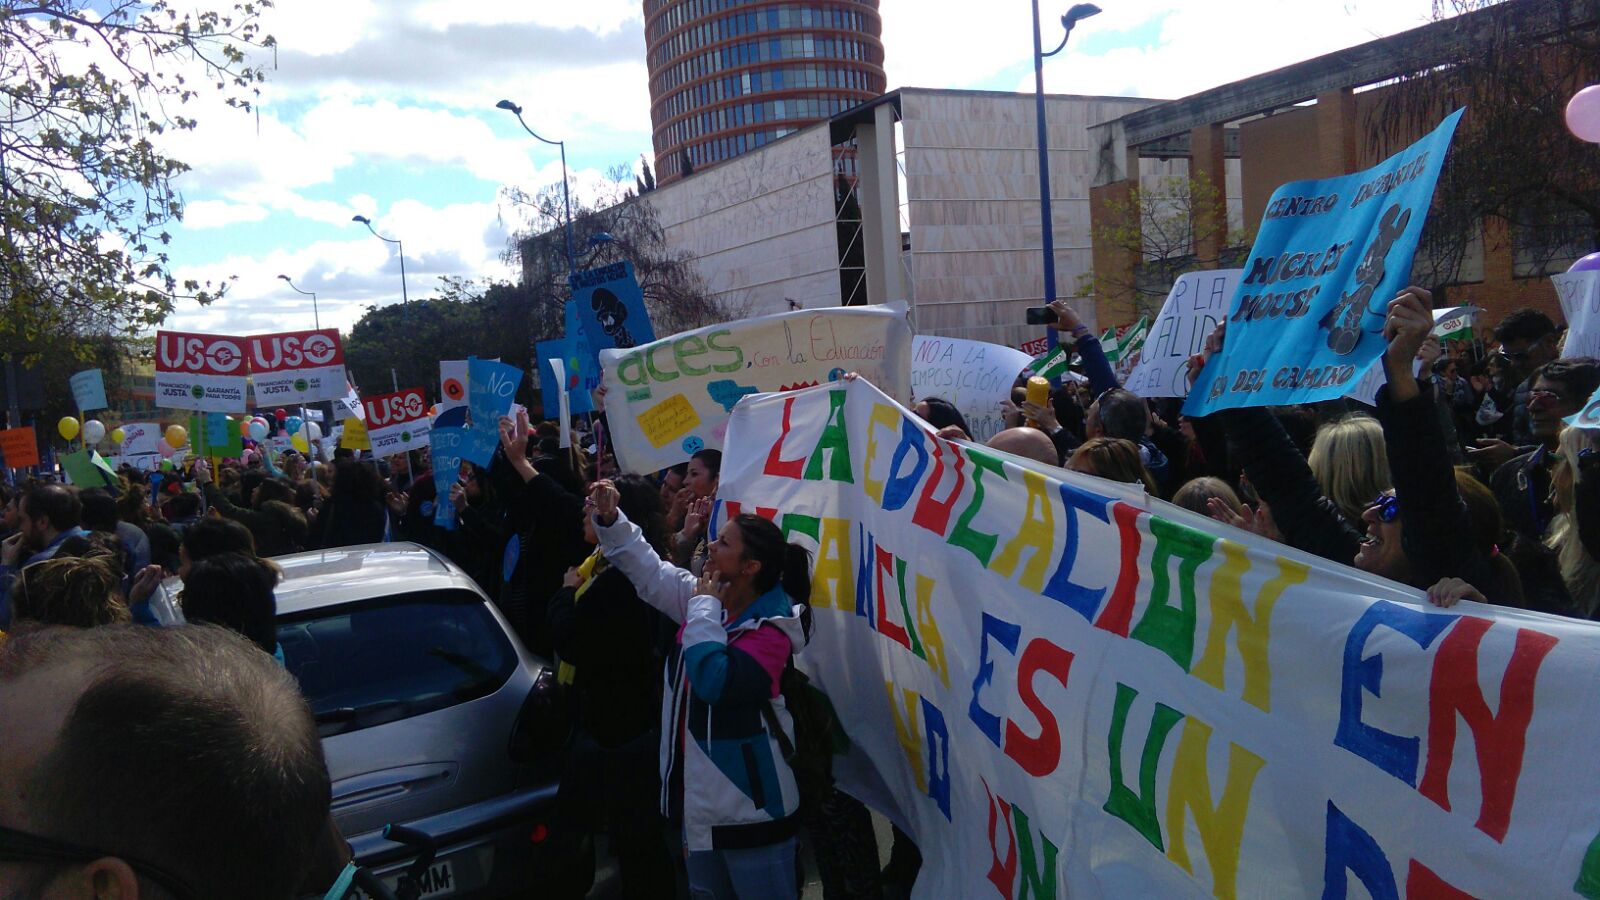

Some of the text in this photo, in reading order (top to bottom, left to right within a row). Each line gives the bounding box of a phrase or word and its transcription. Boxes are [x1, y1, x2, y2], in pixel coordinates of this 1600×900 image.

[1265, 151, 1430, 220] CENTRO INFANTIL
[1194, 278, 1226, 311] LA
[1231, 284, 1321, 322] MOUSE
[160, 335, 242, 372] USO
[252, 334, 336, 369] USO
[783, 320, 807, 364] la
[809, 314, 885, 361] Educación
[914, 340, 986, 365] NO A LA
[163, 388, 187, 397] JUSTA
[206, 386, 241, 395] GARANTÍA
[263, 385, 290, 395] JUSTA
[487, 371, 515, 398] NO
[912, 366, 1008, 393] IMPOSICIÓN
[1148, 367, 1162, 389] EL
[1230, 367, 1268, 393] DEL
[1272, 363, 1356, 391] CAMINO
[366, 392, 425, 426] USO
[377, 438, 399, 448] JUSTA
[764, 389, 1561, 845] LA EDUCACION EN
[968, 611, 1076, 778] ES
[1102, 681, 1267, 900] UN
[978, 774, 1059, 900] UN
